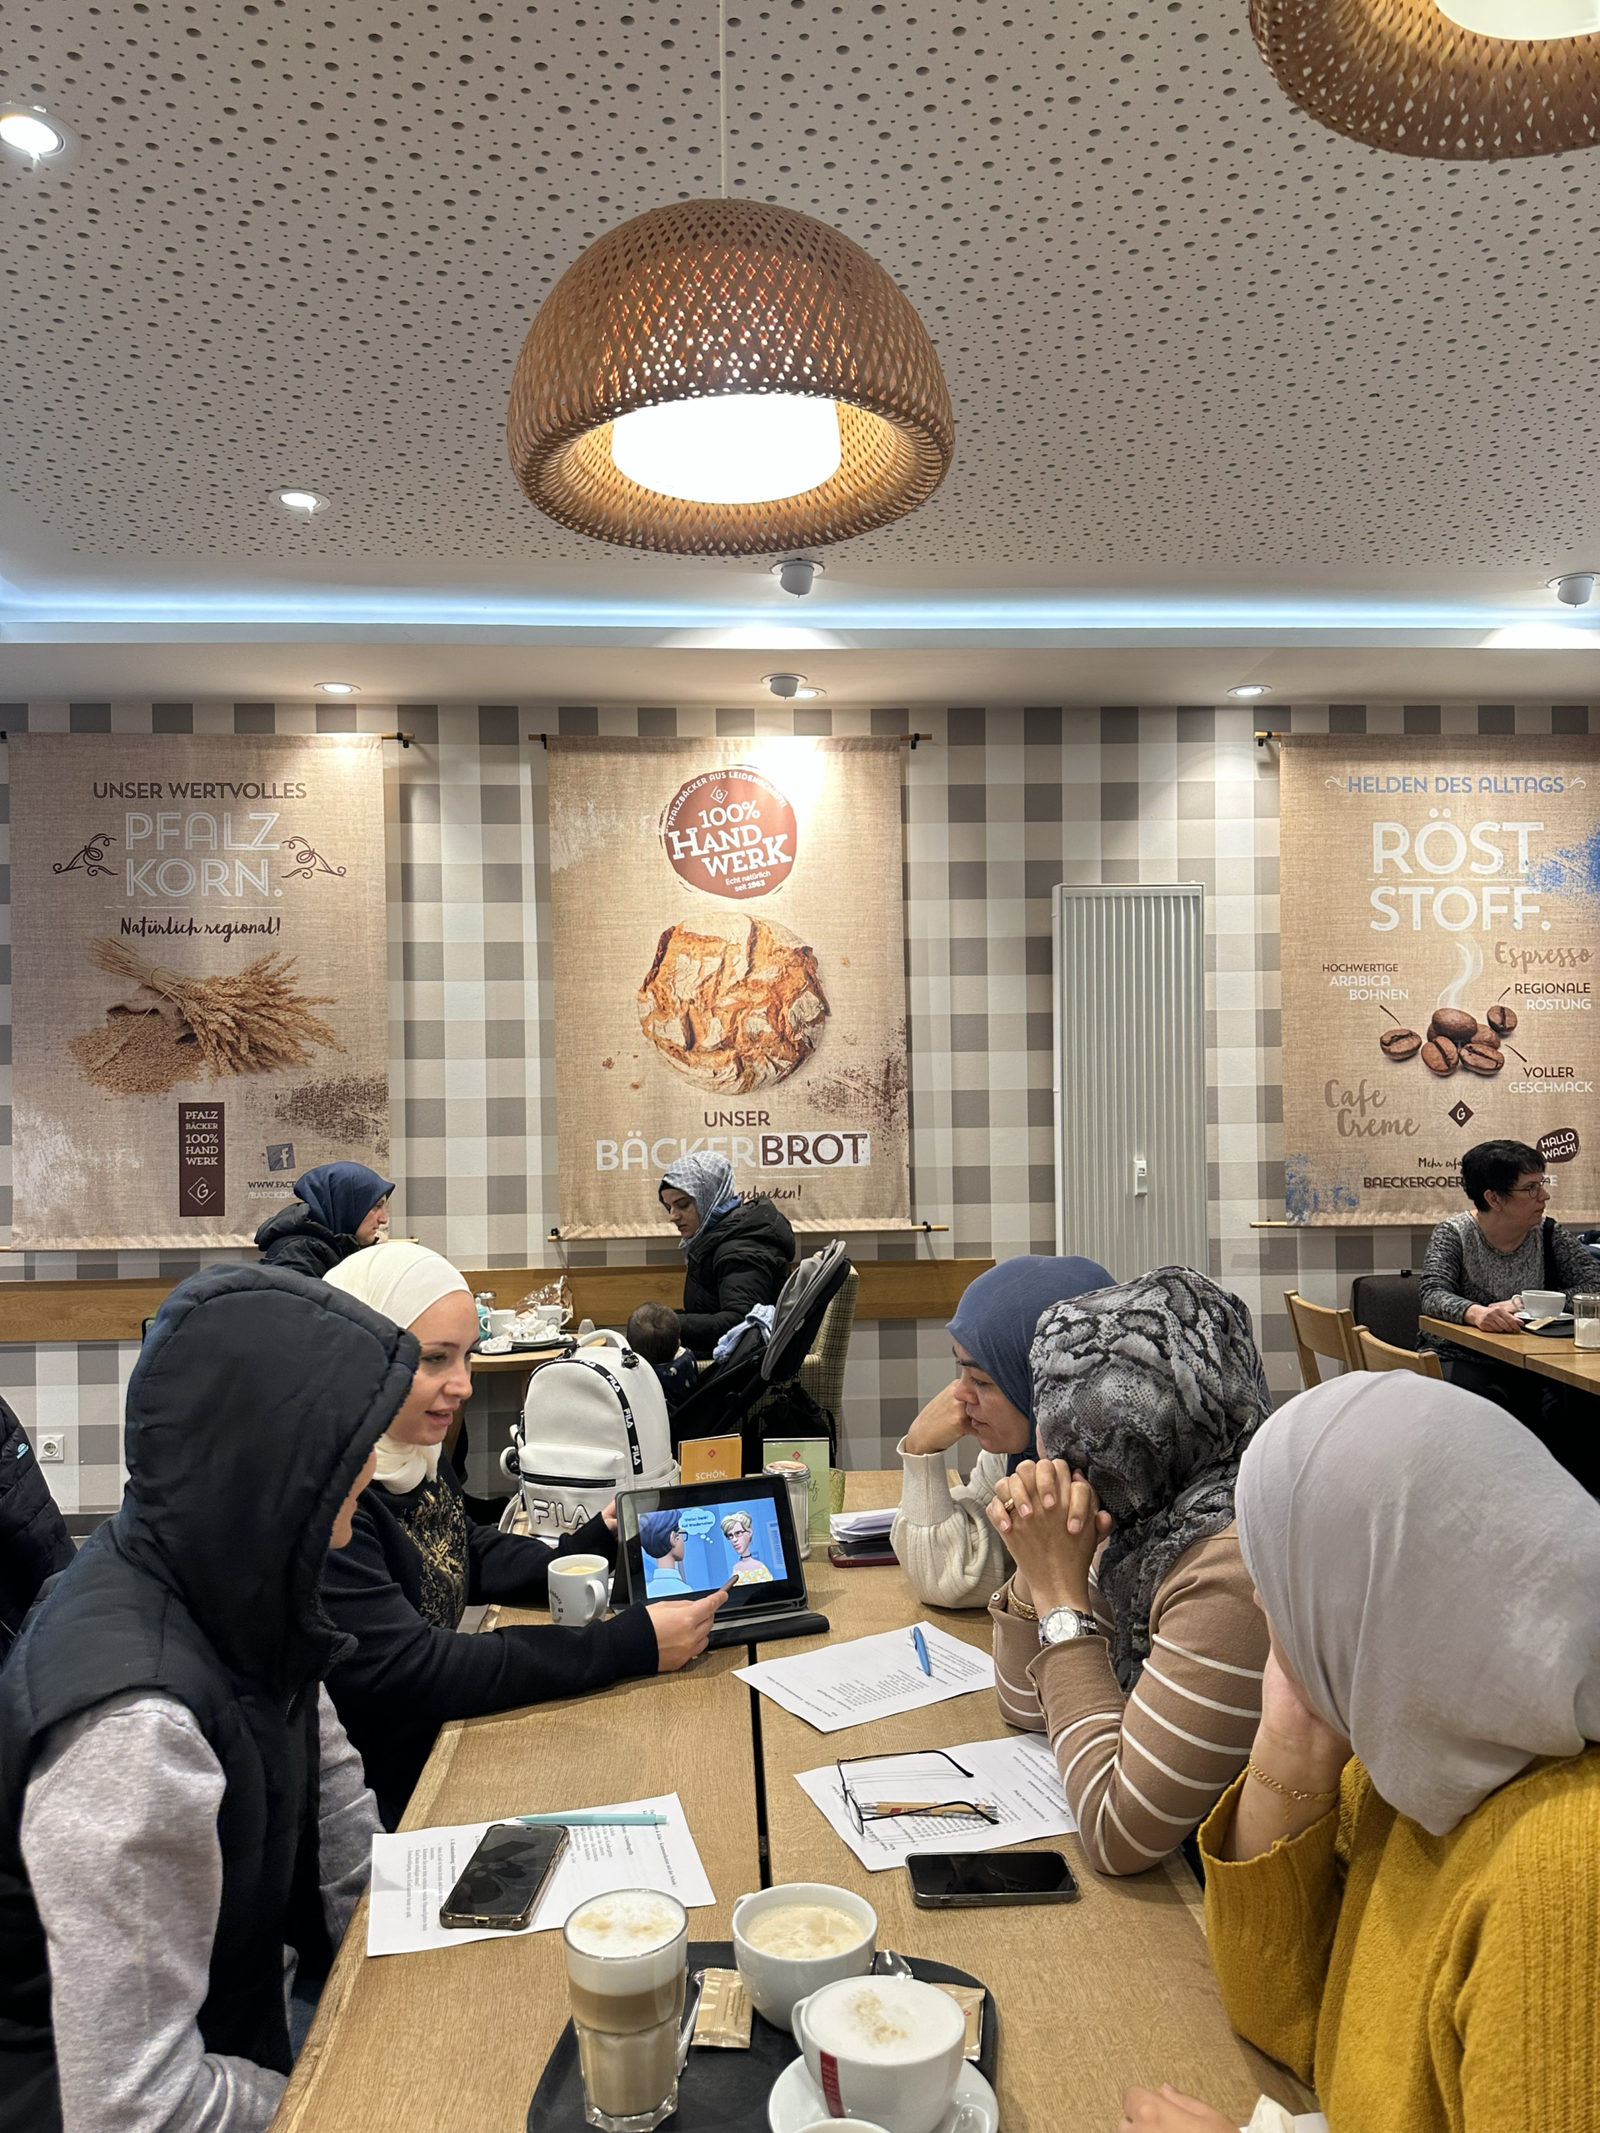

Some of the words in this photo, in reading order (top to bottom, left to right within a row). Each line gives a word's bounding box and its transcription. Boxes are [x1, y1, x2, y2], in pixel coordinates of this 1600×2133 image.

[93, 782, 163, 799] UNSER
[168, 782, 307, 799] WERTVOLLES
[1348, 776, 1428, 793] HELDEN
[1435, 776, 1472, 793] DES
[1478, 776, 1565, 794] ALLTAGS
[668, 777, 708, 827] PFALZBÄCKER
[709, 771, 727, 782] AUS
[698, 799, 761, 829] 100%
[125, 812, 280, 850] PFALZ
[668, 824, 763, 860] HAND
[1373, 807, 1544, 875] RÖST
[701, 834, 793, 878] WERK
[126, 858, 283, 897] KORN.
[725, 876, 741, 886] Echt
[734, 883, 747, 892] seit
[1370, 886, 1551, 932] STOFF.
[120, 916, 203, 937] Natürlich
[204, 916, 281, 943] regional!
[1494, 941, 1594, 974] Espresso
[1322, 963, 1399, 973] HOCHWERTIGE
[1329, 975, 1391, 987] ARABICA
[1514, 982, 1591, 994] REGIONALE
[1349, 989, 1409, 1000] BOHNEN
[1526, 996, 1592, 1010] RÖSTUNG
[1523, 1066, 1574, 1078] VOLLER
[1508, 1081, 1593, 1093] GESCHMACK
[185, 1111, 218, 1120] PFALZ
[704, 1110, 770, 1127] UNSER
[1336, 1108, 1420, 1137] Creme
[185, 1122, 218, 1130] BÄCKER
[185, 1133, 219, 1144] 100%
[1540, 1131, 1575, 1149] HALLO
[185, 1146, 219, 1155] HAND
[1542, 1142, 1577, 1159] WACH!
[185, 1157, 218, 1166] WERK
[1418, 1157, 1443, 1168] Mehr
[1446, 1157, 1463, 1170] erfa
[1363, 1175, 1465, 1189] BAECKERGOER
[606, 1375, 621, 1393] FILA
[623, 1407, 634, 1429] FILA
[631, 1444, 641, 1466] FILA
[695, 1469, 728, 1481] SCHÖN,
[533, 1498, 592, 1531] FILA
